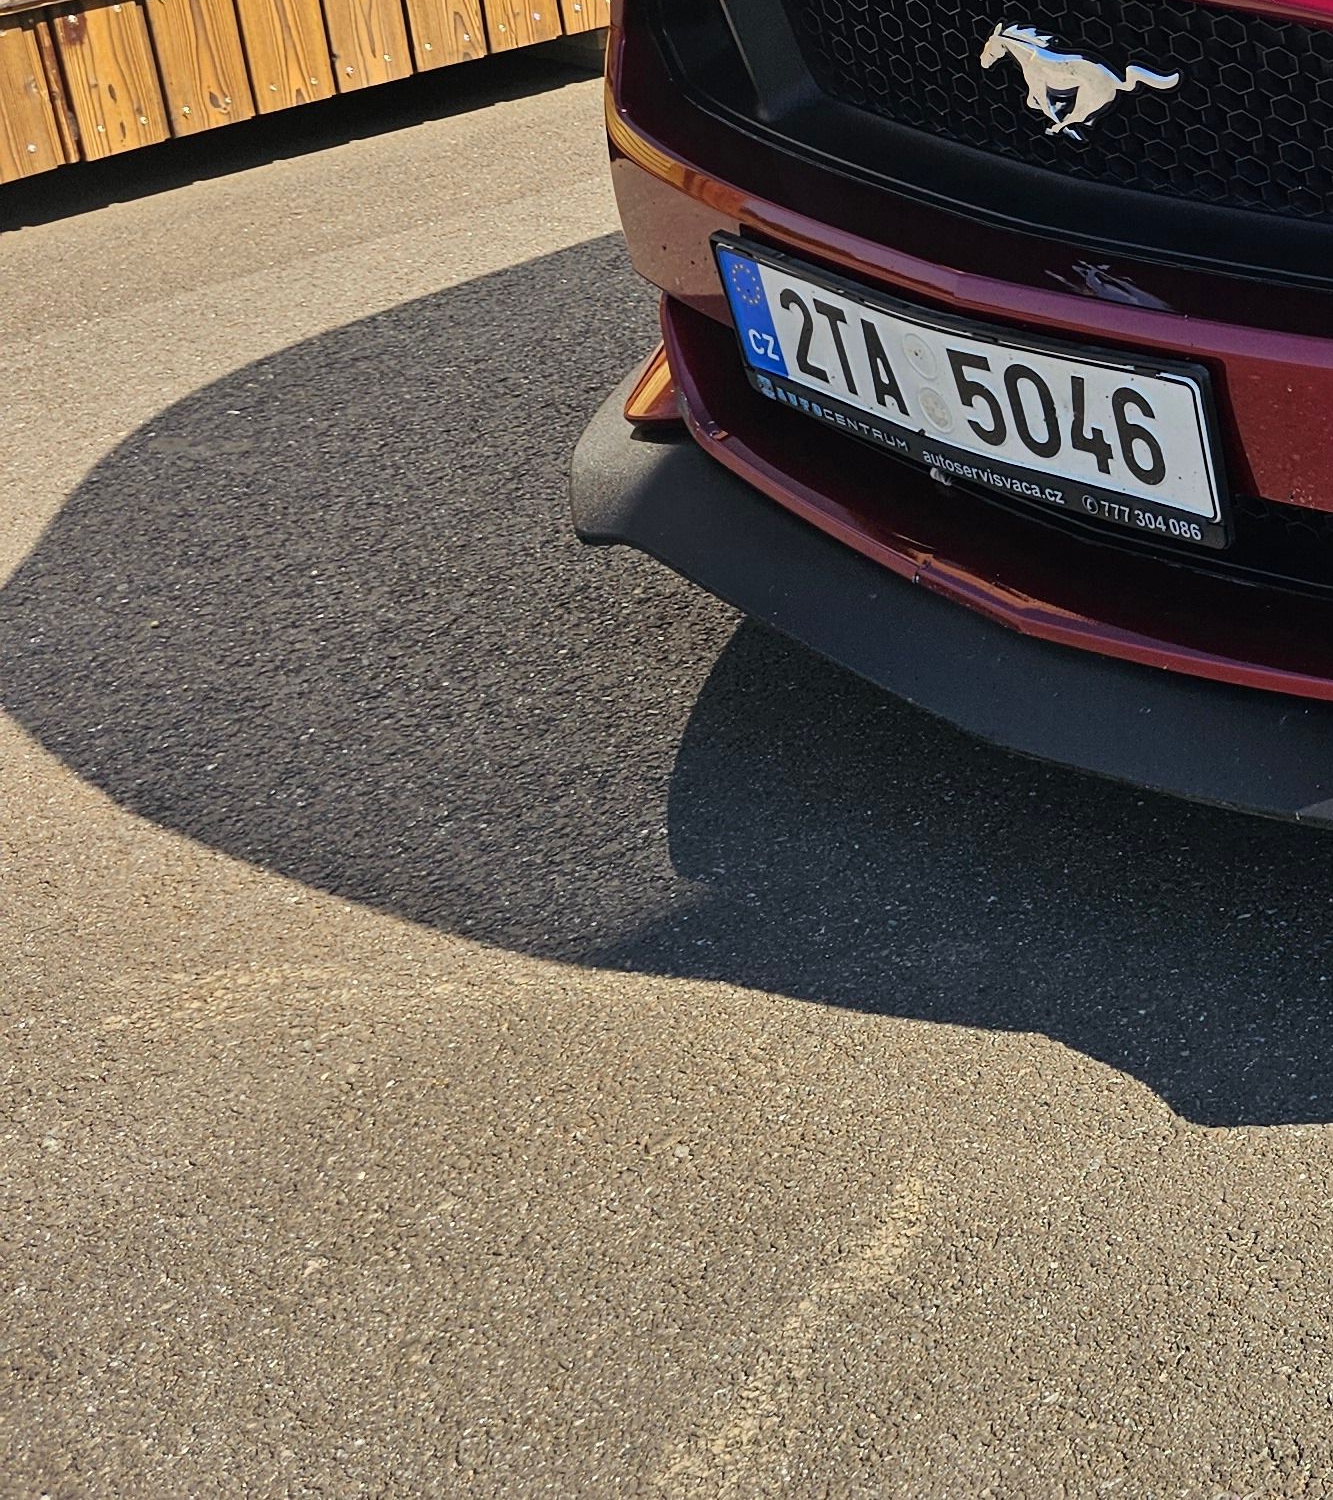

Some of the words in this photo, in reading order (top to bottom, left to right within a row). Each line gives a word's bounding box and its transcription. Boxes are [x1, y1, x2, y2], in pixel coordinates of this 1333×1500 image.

[748, 328, 780, 362] CZ
[779, 288, 910, 417] 2TA
[945, 348, 1167, 486] 5046
[922, 448, 1066, 505] autoservisvaca.cz
[1100, 499, 1131, 524] 777
[1134, 510, 1168, 533] 304
[1169, 518, 1203, 542] 086
